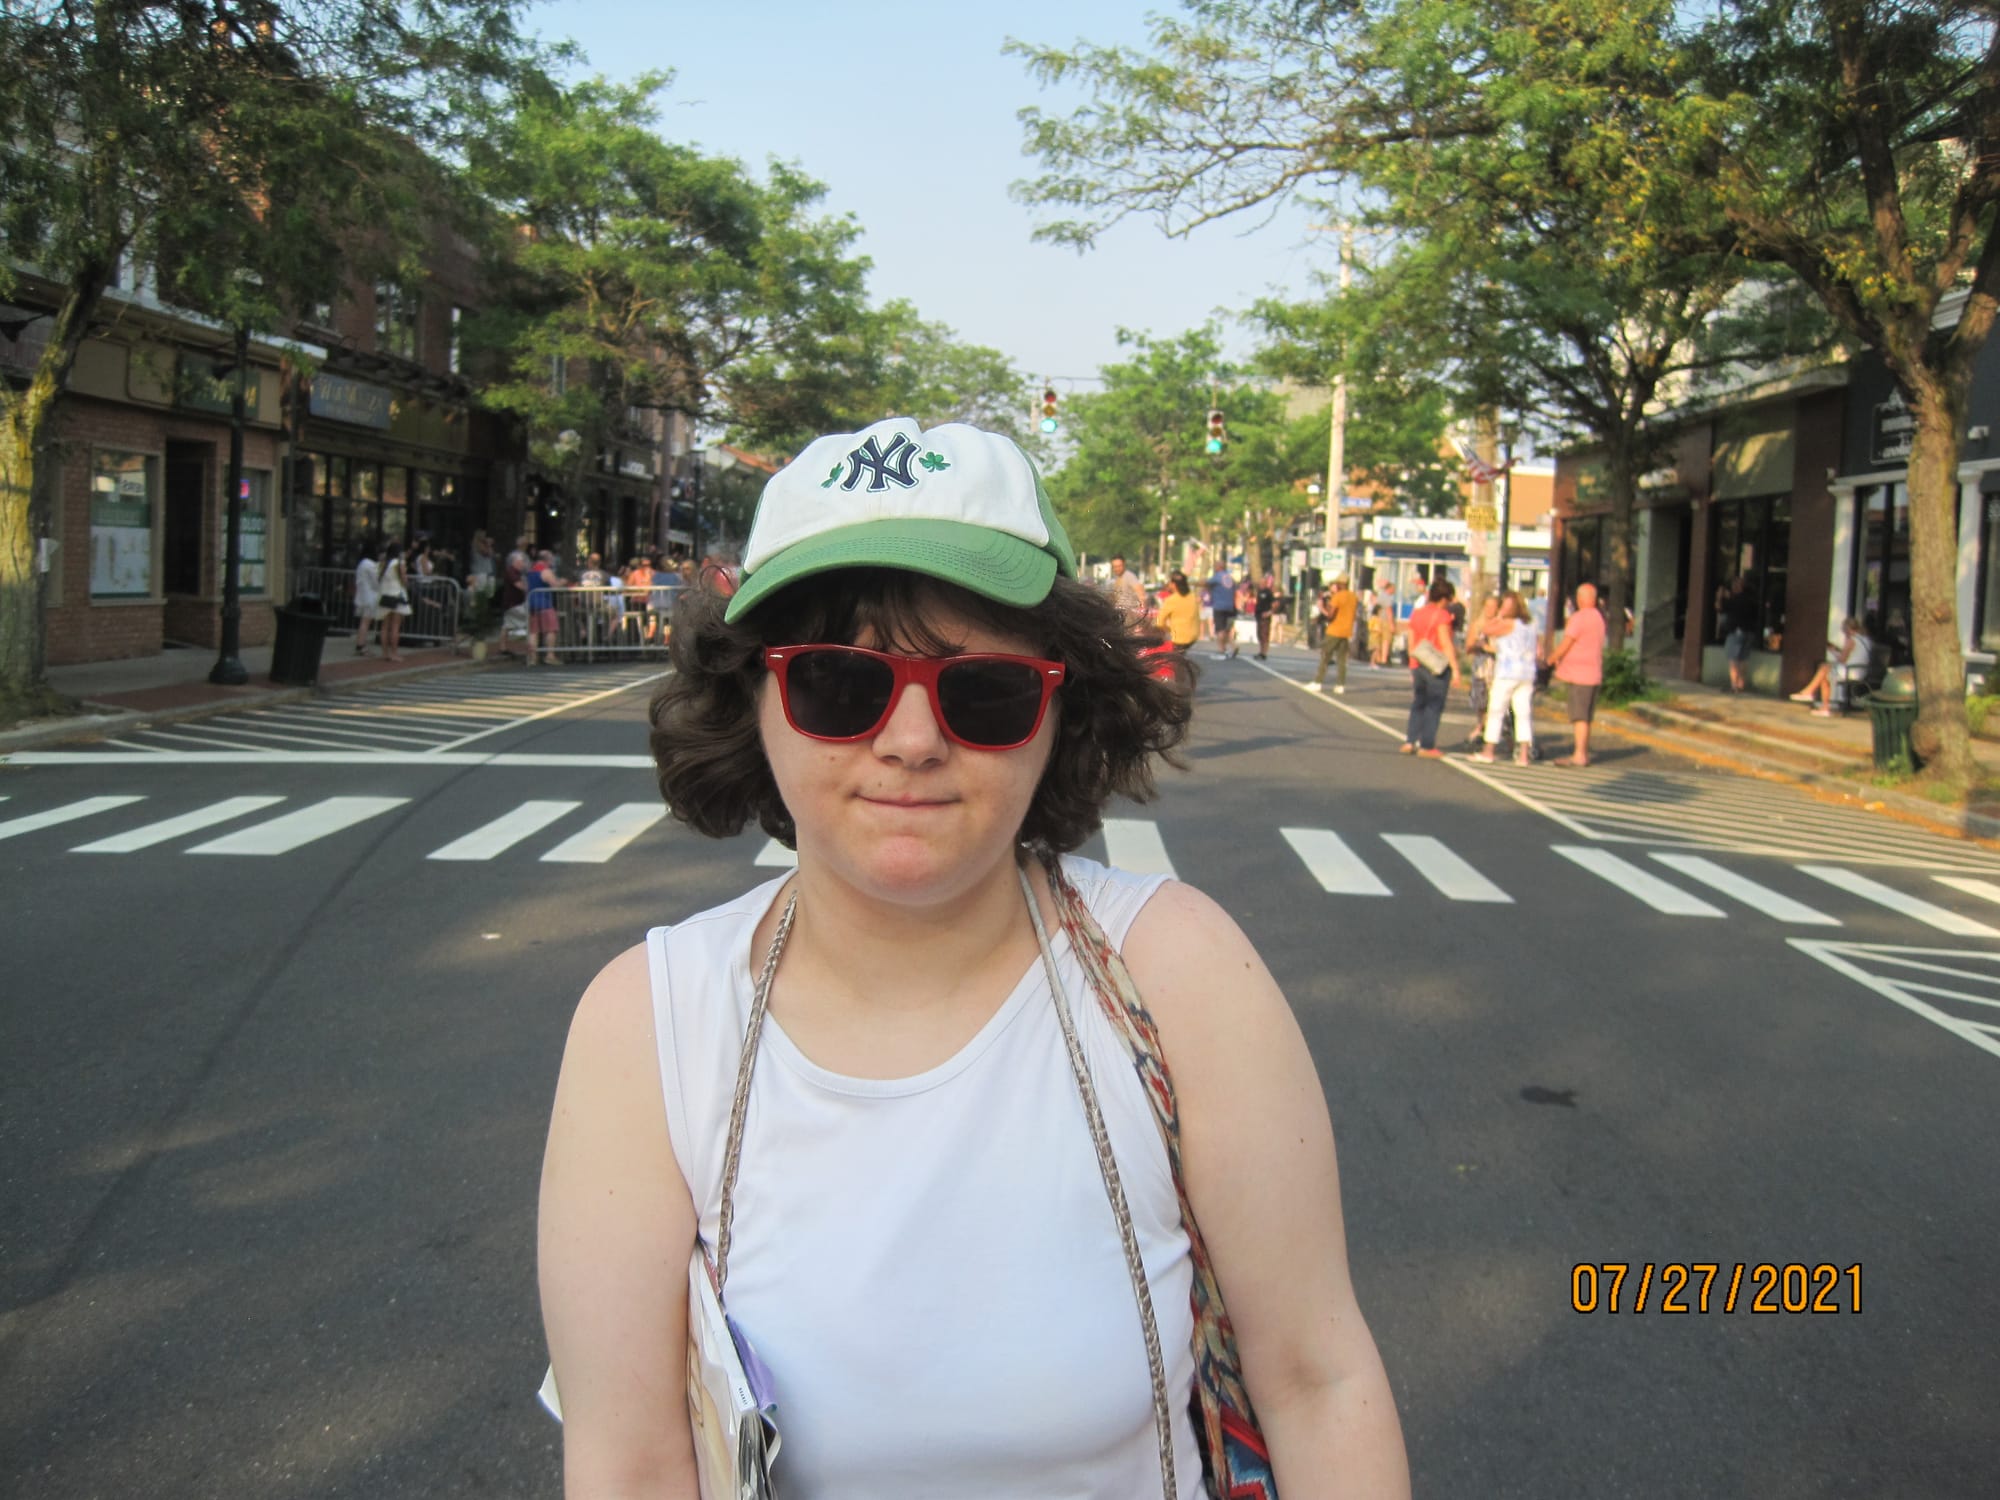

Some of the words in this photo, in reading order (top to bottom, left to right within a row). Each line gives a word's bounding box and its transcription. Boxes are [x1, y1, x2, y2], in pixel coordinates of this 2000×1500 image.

[841, 432, 921, 492] NY
[1380, 525, 1472, 542] CLEANER
[1323, 552, 1334, 566] P
